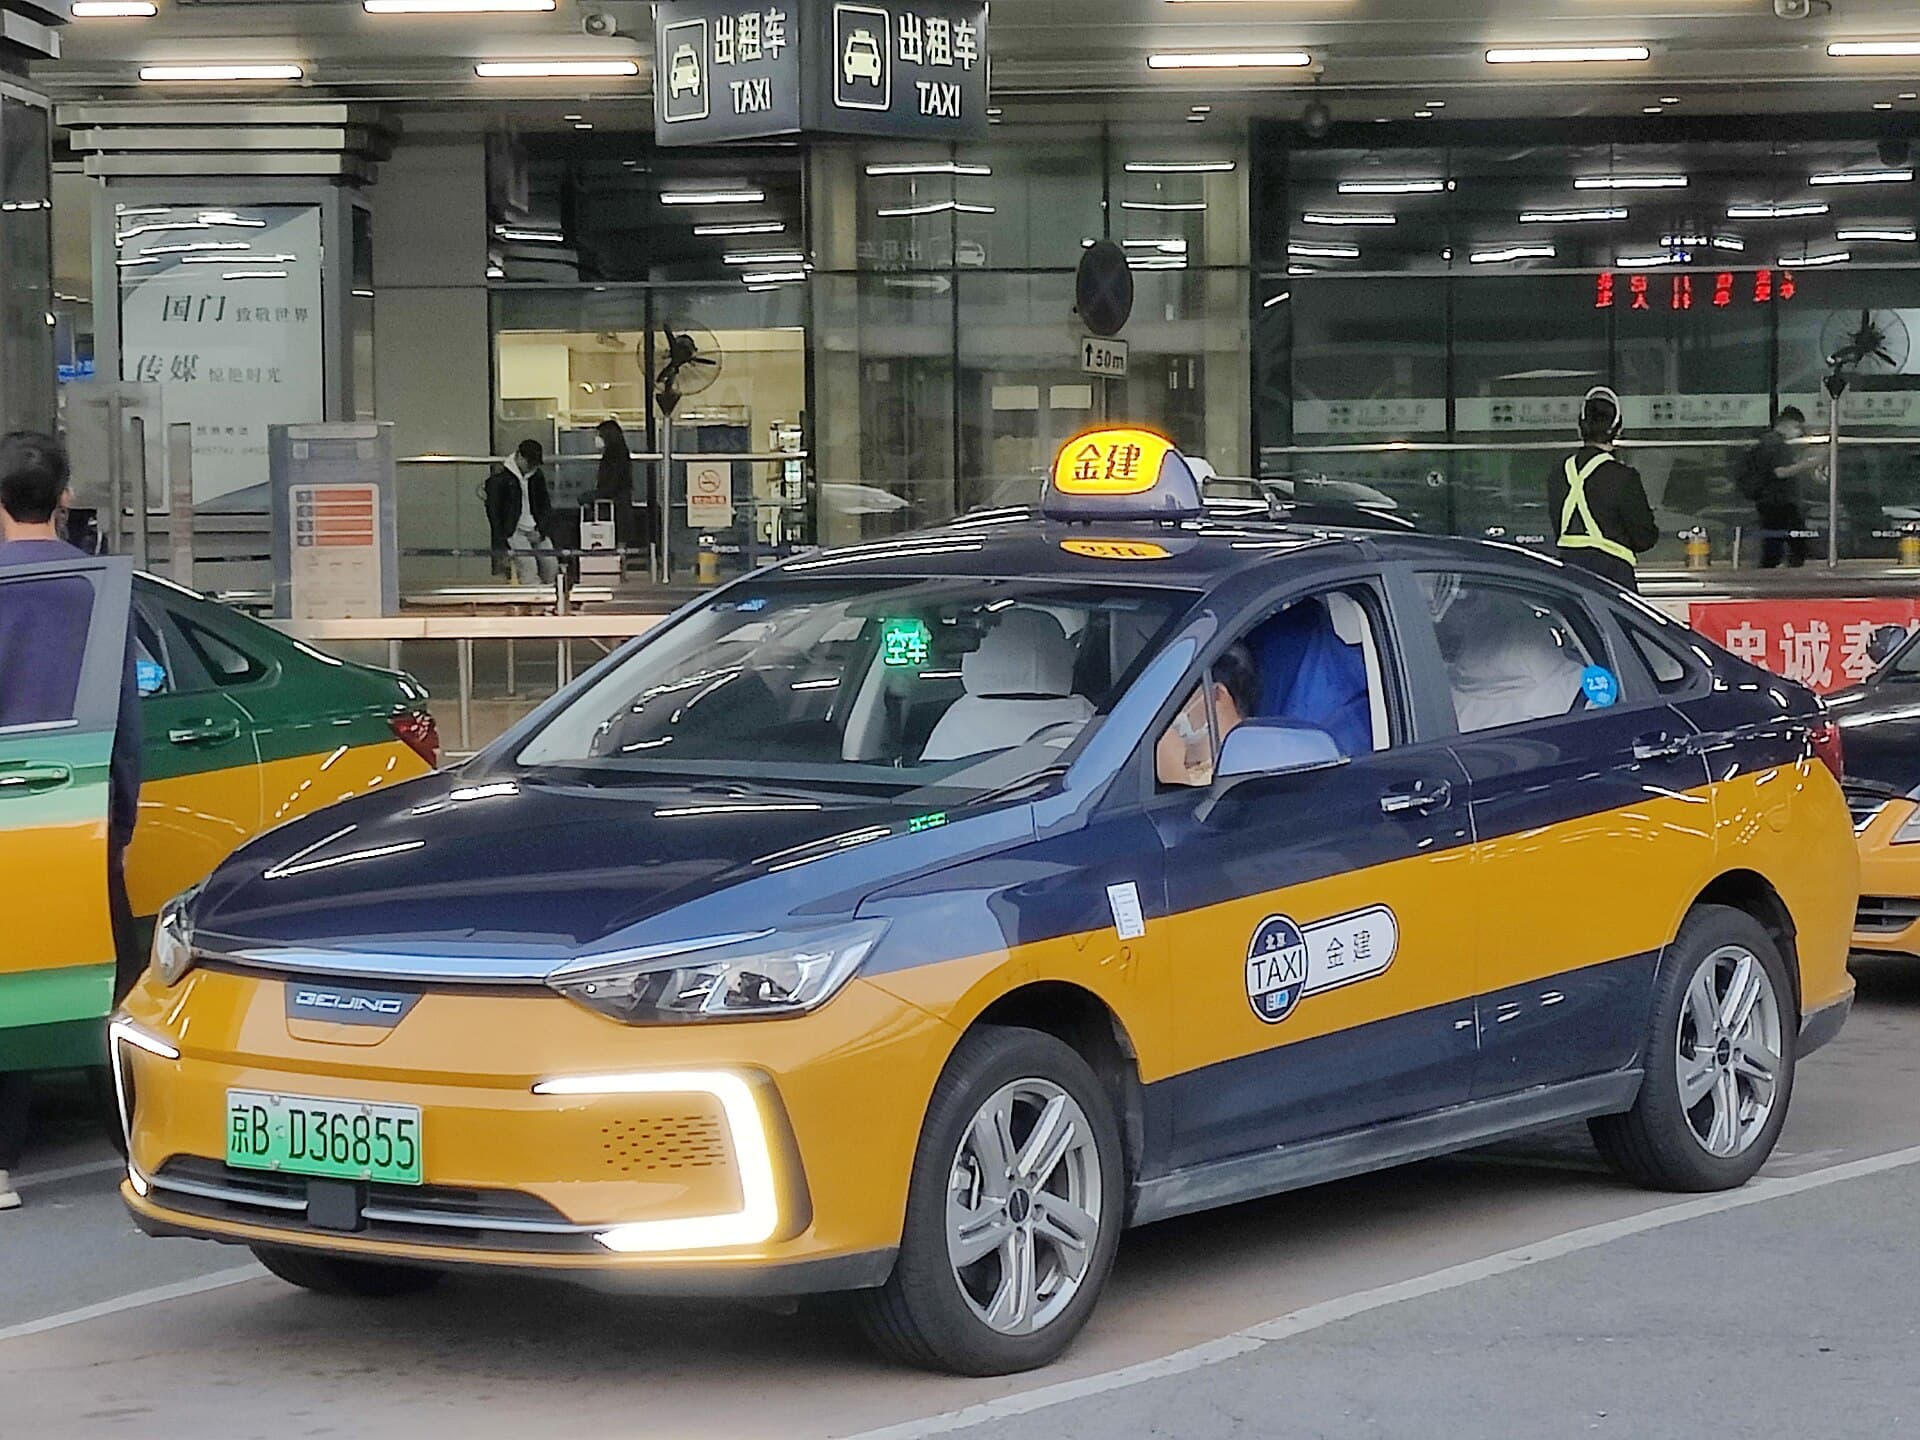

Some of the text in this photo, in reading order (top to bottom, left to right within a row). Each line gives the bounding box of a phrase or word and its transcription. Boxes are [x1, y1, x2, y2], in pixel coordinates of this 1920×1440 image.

[714, 7, 787, 67] 出租车
[898, 11, 979, 71] 出租车
[729, 77, 772, 115] TAXI
[915, 80, 961, 118] TAXI
[162, 294, 226, 322] 国门
[136, 353, 200, 383] 传媒
[1095, 347, 1124, 370] 50m
[1071, 443, 1142, 481] 金建
[884, 627, 929, 666] 空车
[1326, 929, 1373, 970] 金建
[1252, 949, 1302, 989] TAXI
[296, 990, 402, 1014] BEIJING
